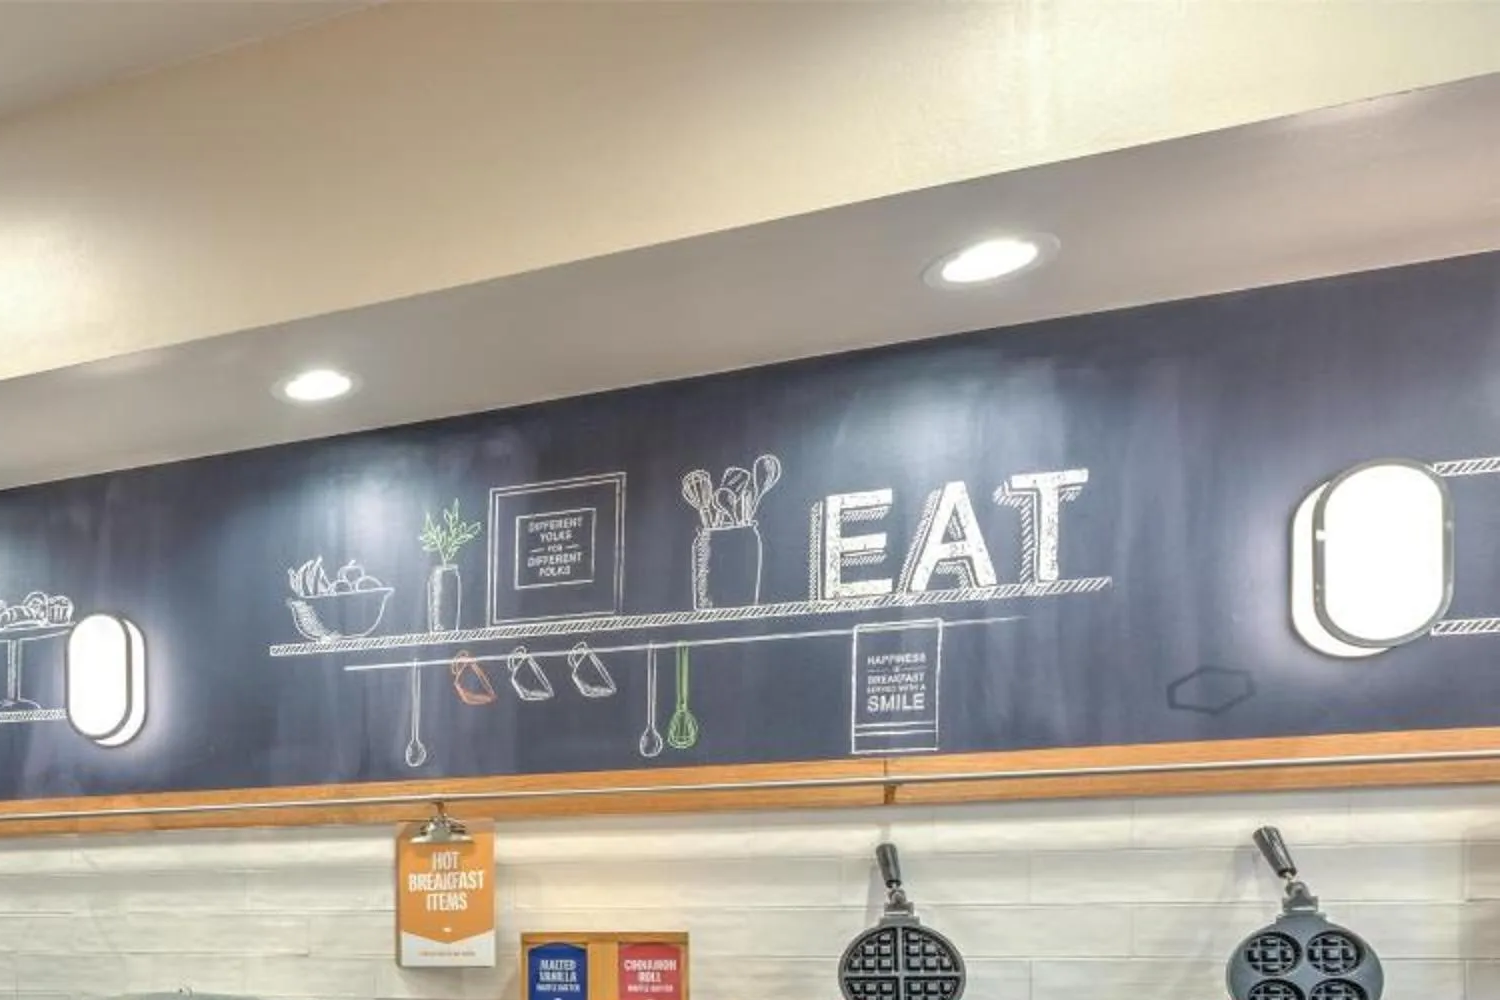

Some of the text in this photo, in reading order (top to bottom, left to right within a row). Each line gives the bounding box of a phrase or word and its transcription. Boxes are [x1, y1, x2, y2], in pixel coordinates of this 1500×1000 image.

[528, 516, 583, 533] DIFFERENT
[540, 530, 573, 543] YOLKS
[809, 468, 1089, 600] EAT
[527, 551, 582, 568] DIFFERENT
[539, 565, 571, 577] FOLKS
[867, 652, 927, 666] HAPPINESS
[867, 671, 925, 685] BREAKFAST
[867, 692, 925, 712] SMILE
[432, 851, 461, 871] HOT
[408, 871, 486, 892] BREAKFAST
[426, 892, 469, 912] ITEMS
[540, 959, 577, 971] MALTED
[623, 959, 677, 971] CINNAMON
[539, 971, 577, 983] VANILLA
[637, 971, 661, 983] ROLL
